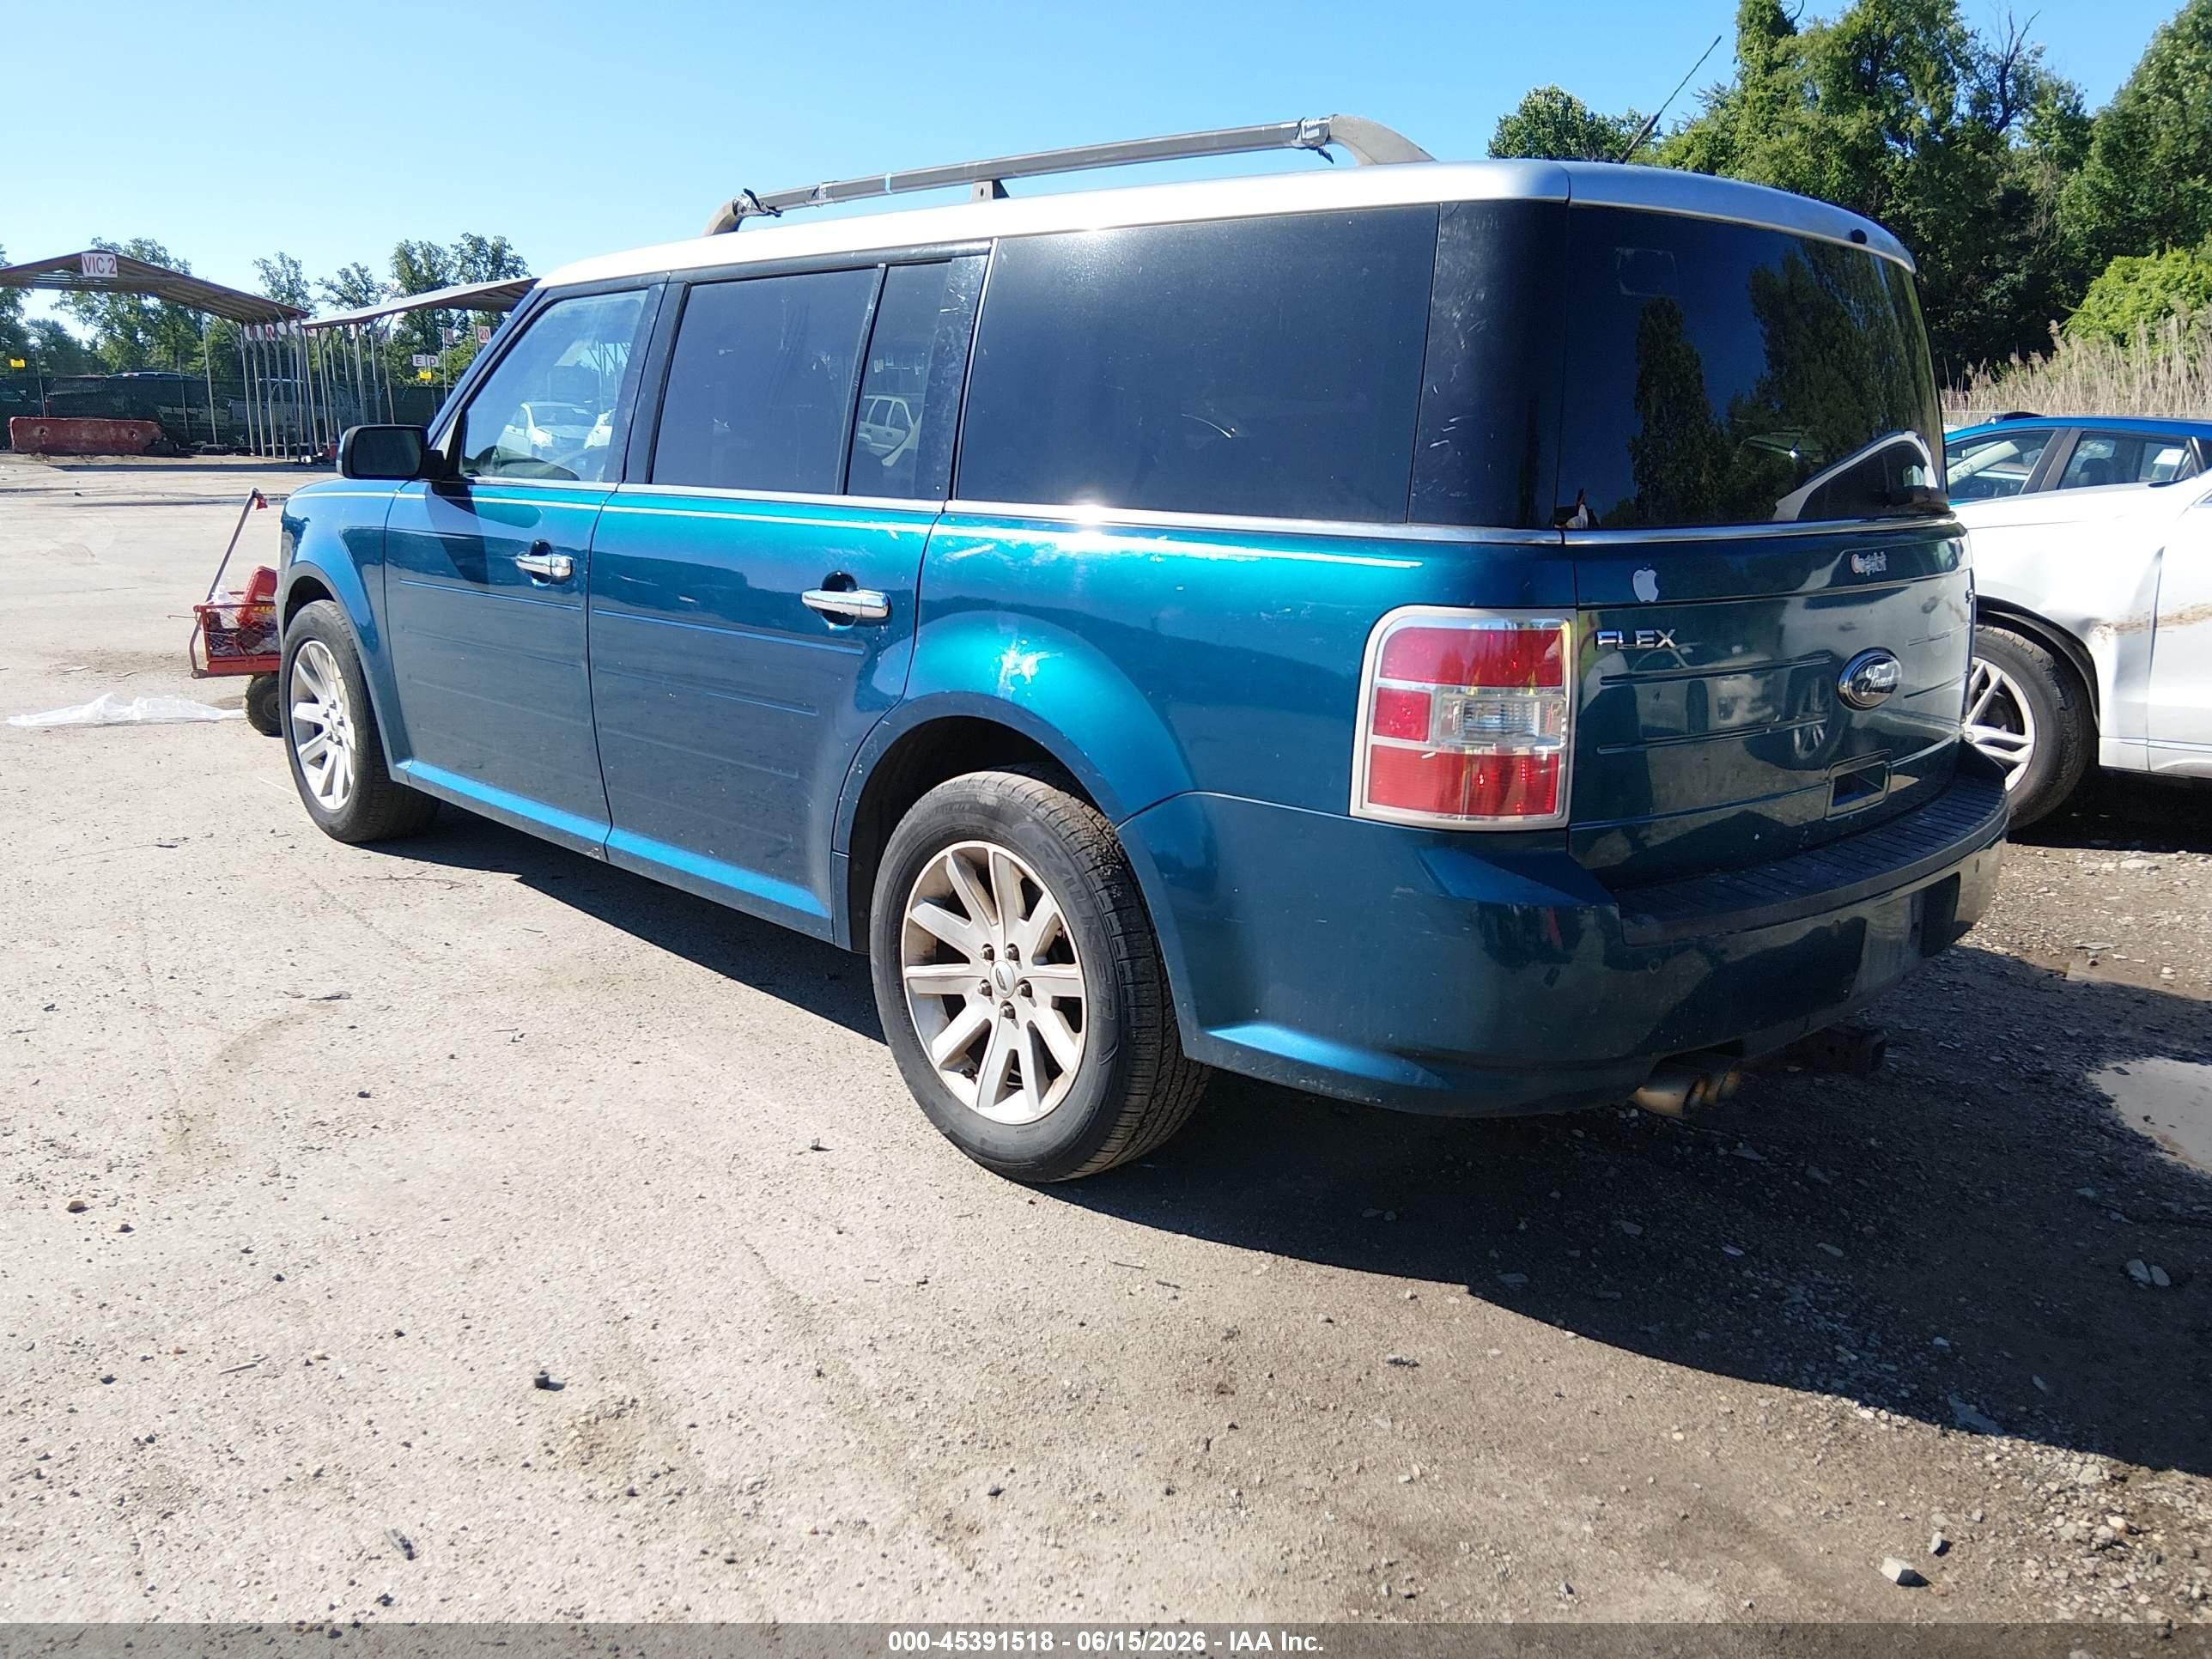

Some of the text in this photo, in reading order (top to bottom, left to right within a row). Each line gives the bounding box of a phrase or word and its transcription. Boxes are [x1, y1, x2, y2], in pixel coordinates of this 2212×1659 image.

[82, 257, 117, 274] VIC 2
[1595, 629, 1676, 650] FLEX
[1861, 663, 1895, 697] Ford
